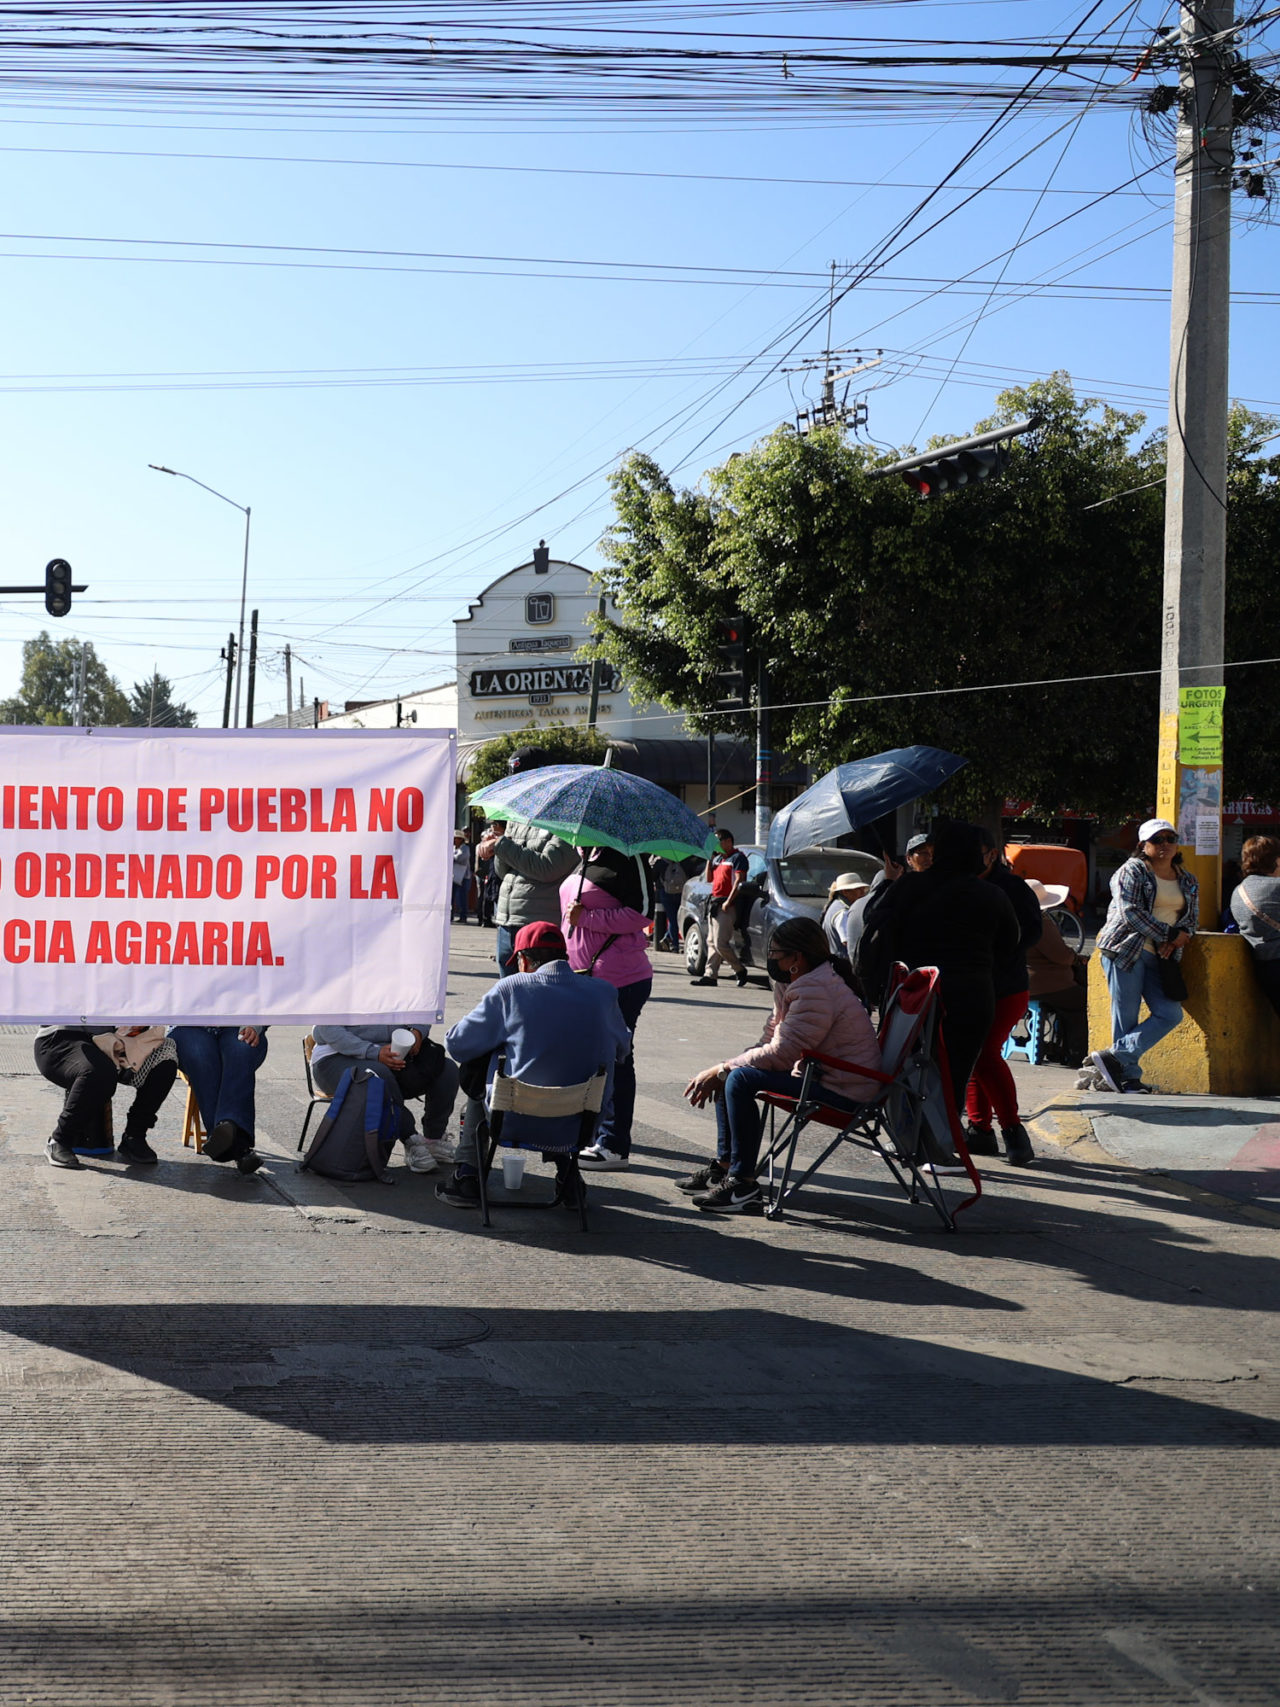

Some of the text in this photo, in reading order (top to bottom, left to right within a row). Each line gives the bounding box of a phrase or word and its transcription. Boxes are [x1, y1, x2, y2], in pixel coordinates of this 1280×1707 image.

[475, 674, 503, 693] LA
[1186, 689, 1222, 700] FOTOS
[539, 706, 570, 717] TACOS
[136, 787, 188, 832] DE
[200, 788, 357, 833] PUEBLA
[367, 786, 425, 833] NO
[14, 851, 243, 900] ORDENADO
[254, 854, 337, 900] POR
[349, 854, 400, 900] LA
[85, 920, 285, 967] AGRARIA.
